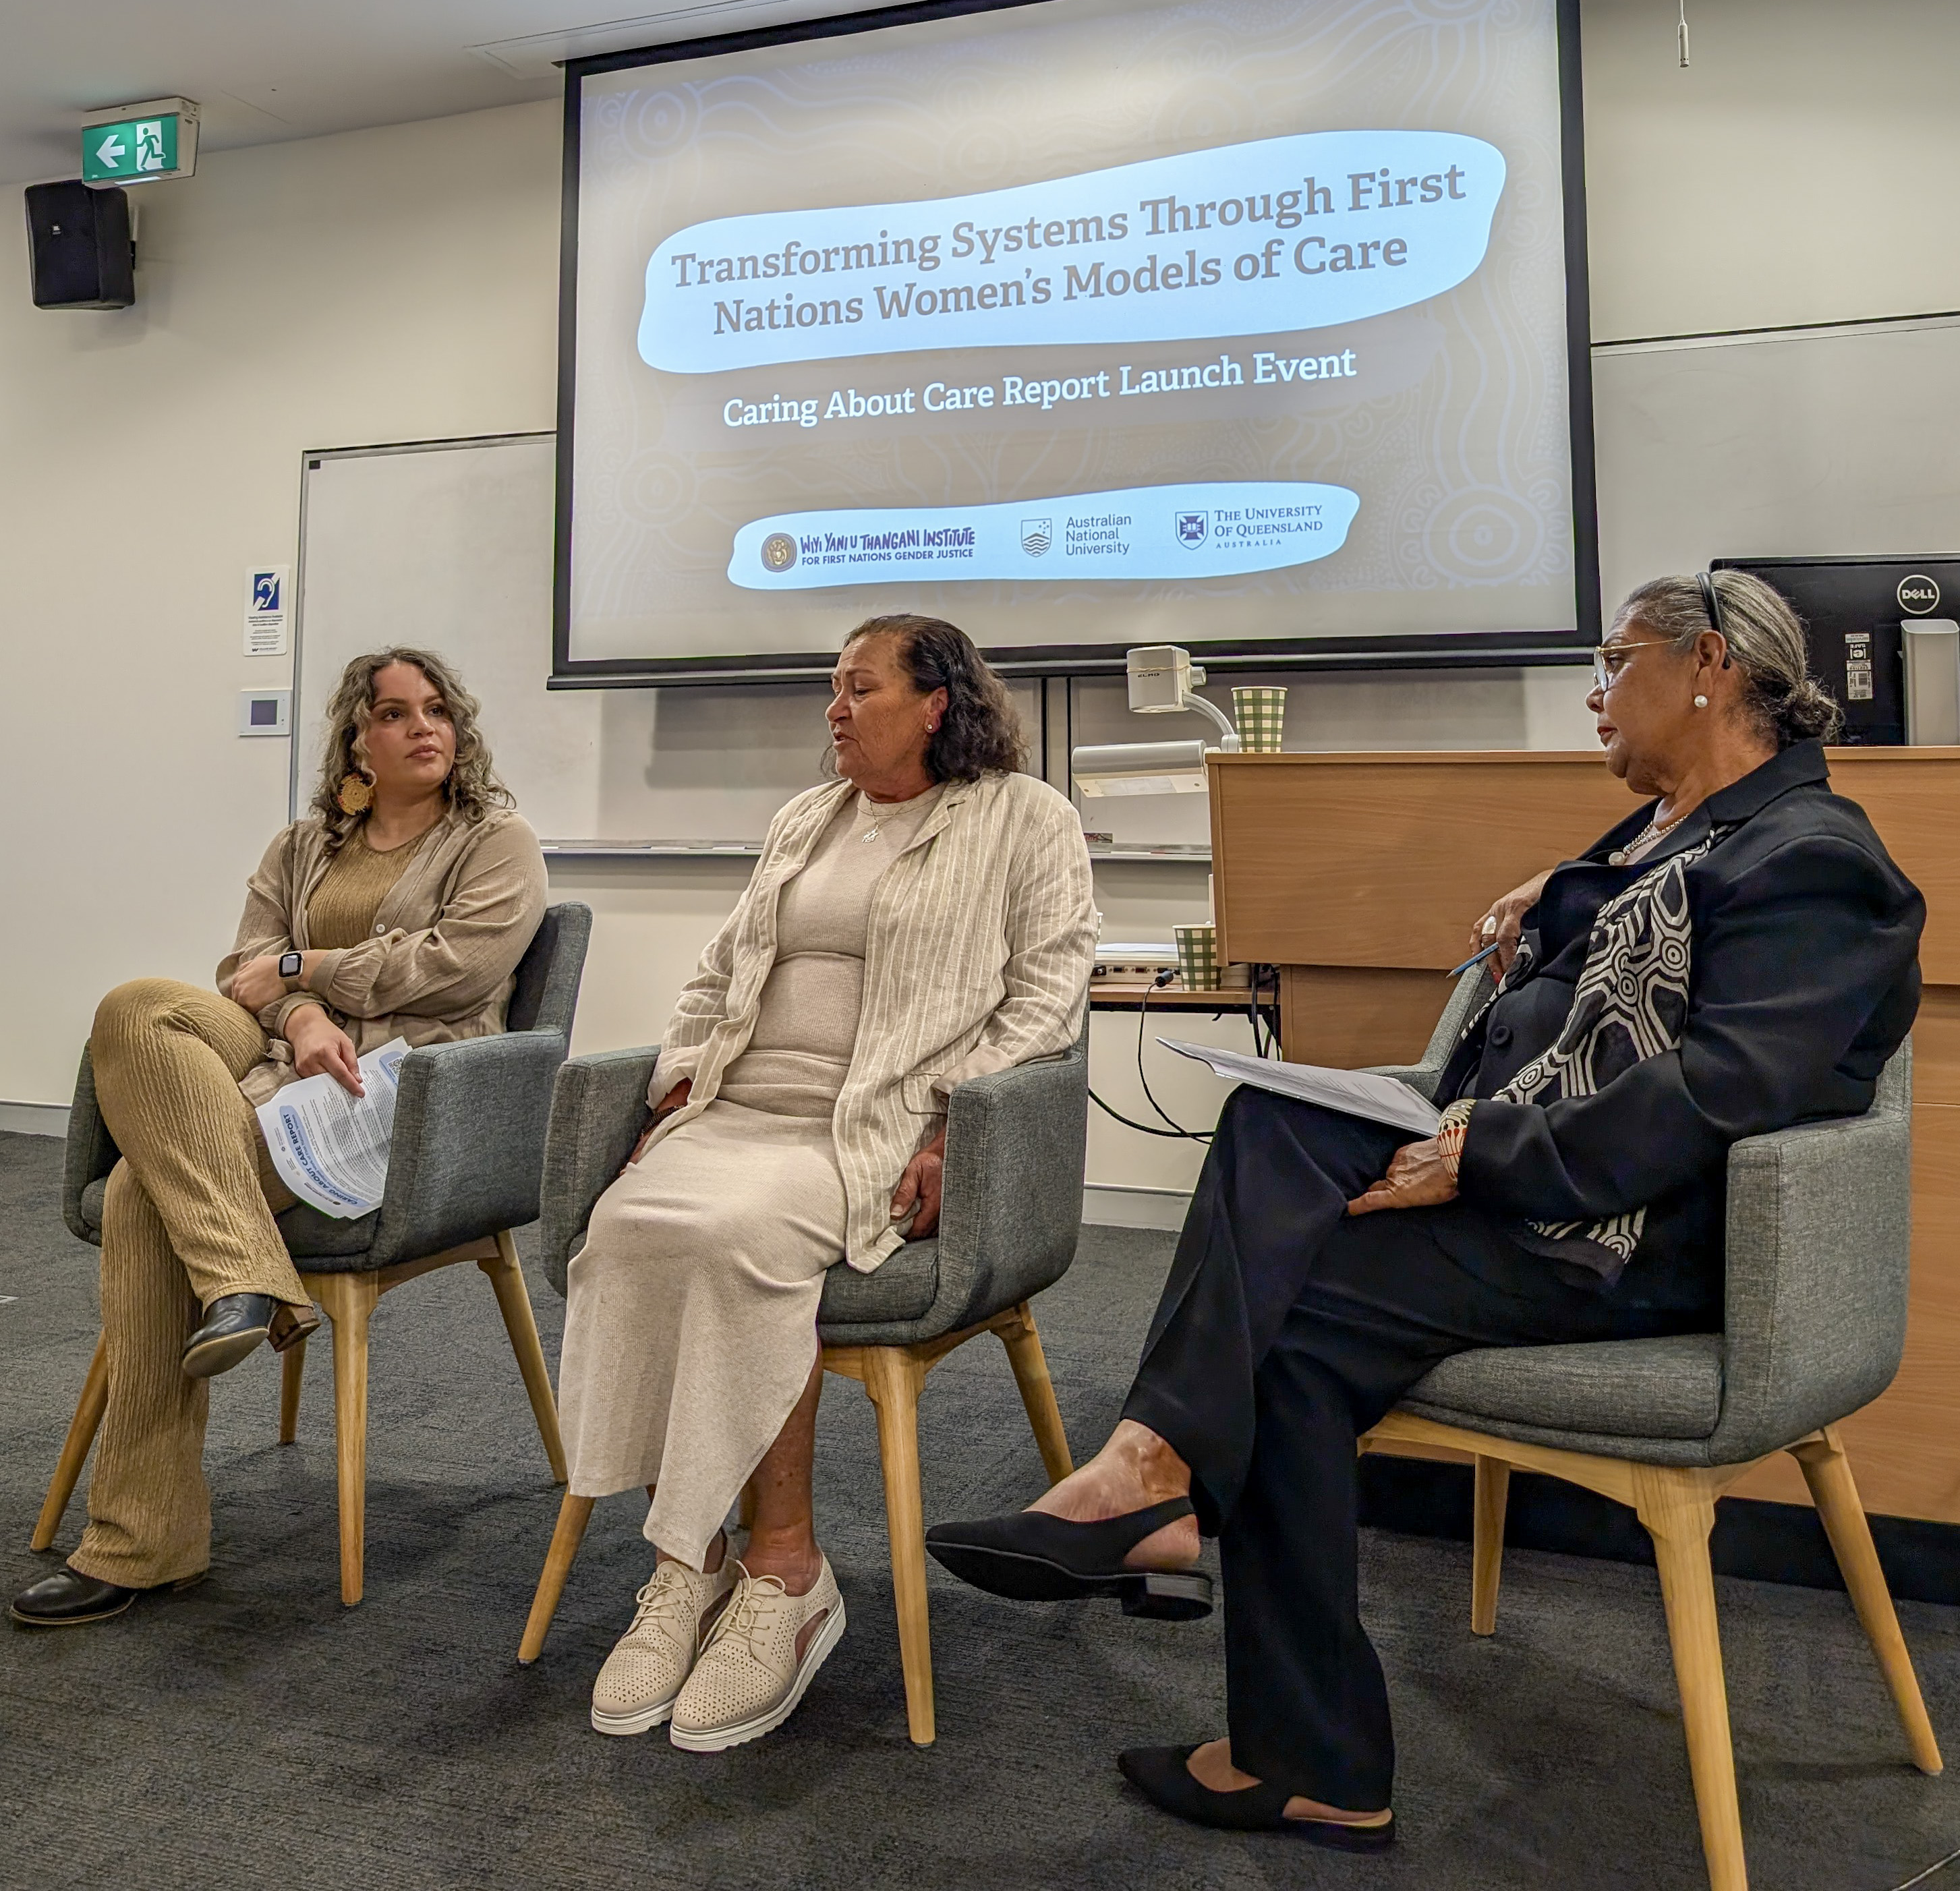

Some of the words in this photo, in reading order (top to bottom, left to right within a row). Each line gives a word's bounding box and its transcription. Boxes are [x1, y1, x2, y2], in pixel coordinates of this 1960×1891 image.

[671, 229, 941, 287] Transforming
[952, 213, 1128, 264] Systems
[1139, 177, 1335, 229] Through
[1347, 164, 1466, 211] First
[714, 293, 863, 335] Nations
[873, 267, 1051, 320] Women's
[1063, 250, 1221, 301] Models
[1234, 239, 1285, 281] of
[1294, 236, 1408, 274] Care
[723, 394, 818, 427] Caring
[824, 386, 915, 419] About
[923, 382, 993, 411] Care
[1002, 370, 1110, 409] Report
[1118, 355, 1244, 395] Launch
[1252, 348, 1357, 384] Event
[1066, 513, 1132, 529] Australian
[1214, 509, 1242, 522] THE
[1245, 505, 1323, 520] UNIVERSITY
[1066, 527, 1120, 542] National
[1214, 525, 1233, 537] OF
[1236, 521, 1323, 538] QUEENSLAND
[850, 535, 858, 549] U
[859, 529, 920, 550] THANGANI
[923, 527, 975, 547] INSTITUTE
[1215, 539, 1281, 549] AUSTRALIA
[802, 556, 820, 566] FOR
[823, 554, 846, 564] FIRST
[848, 552, 892, 563] NATIONS
[894, 550, 934, 560] GENDER
[936, 548, 973, 559] JUSTICE
[1066, 541, 1130, 556] University
[1901, 588, 1935, 600] DELL
[283, 1113, 299, 1144] REPORT
[295, 1145, 308, 1166] CARE
[306, 1167, 329, 1188] ABOUT
[328, 1189, 357, 1204] CARING
